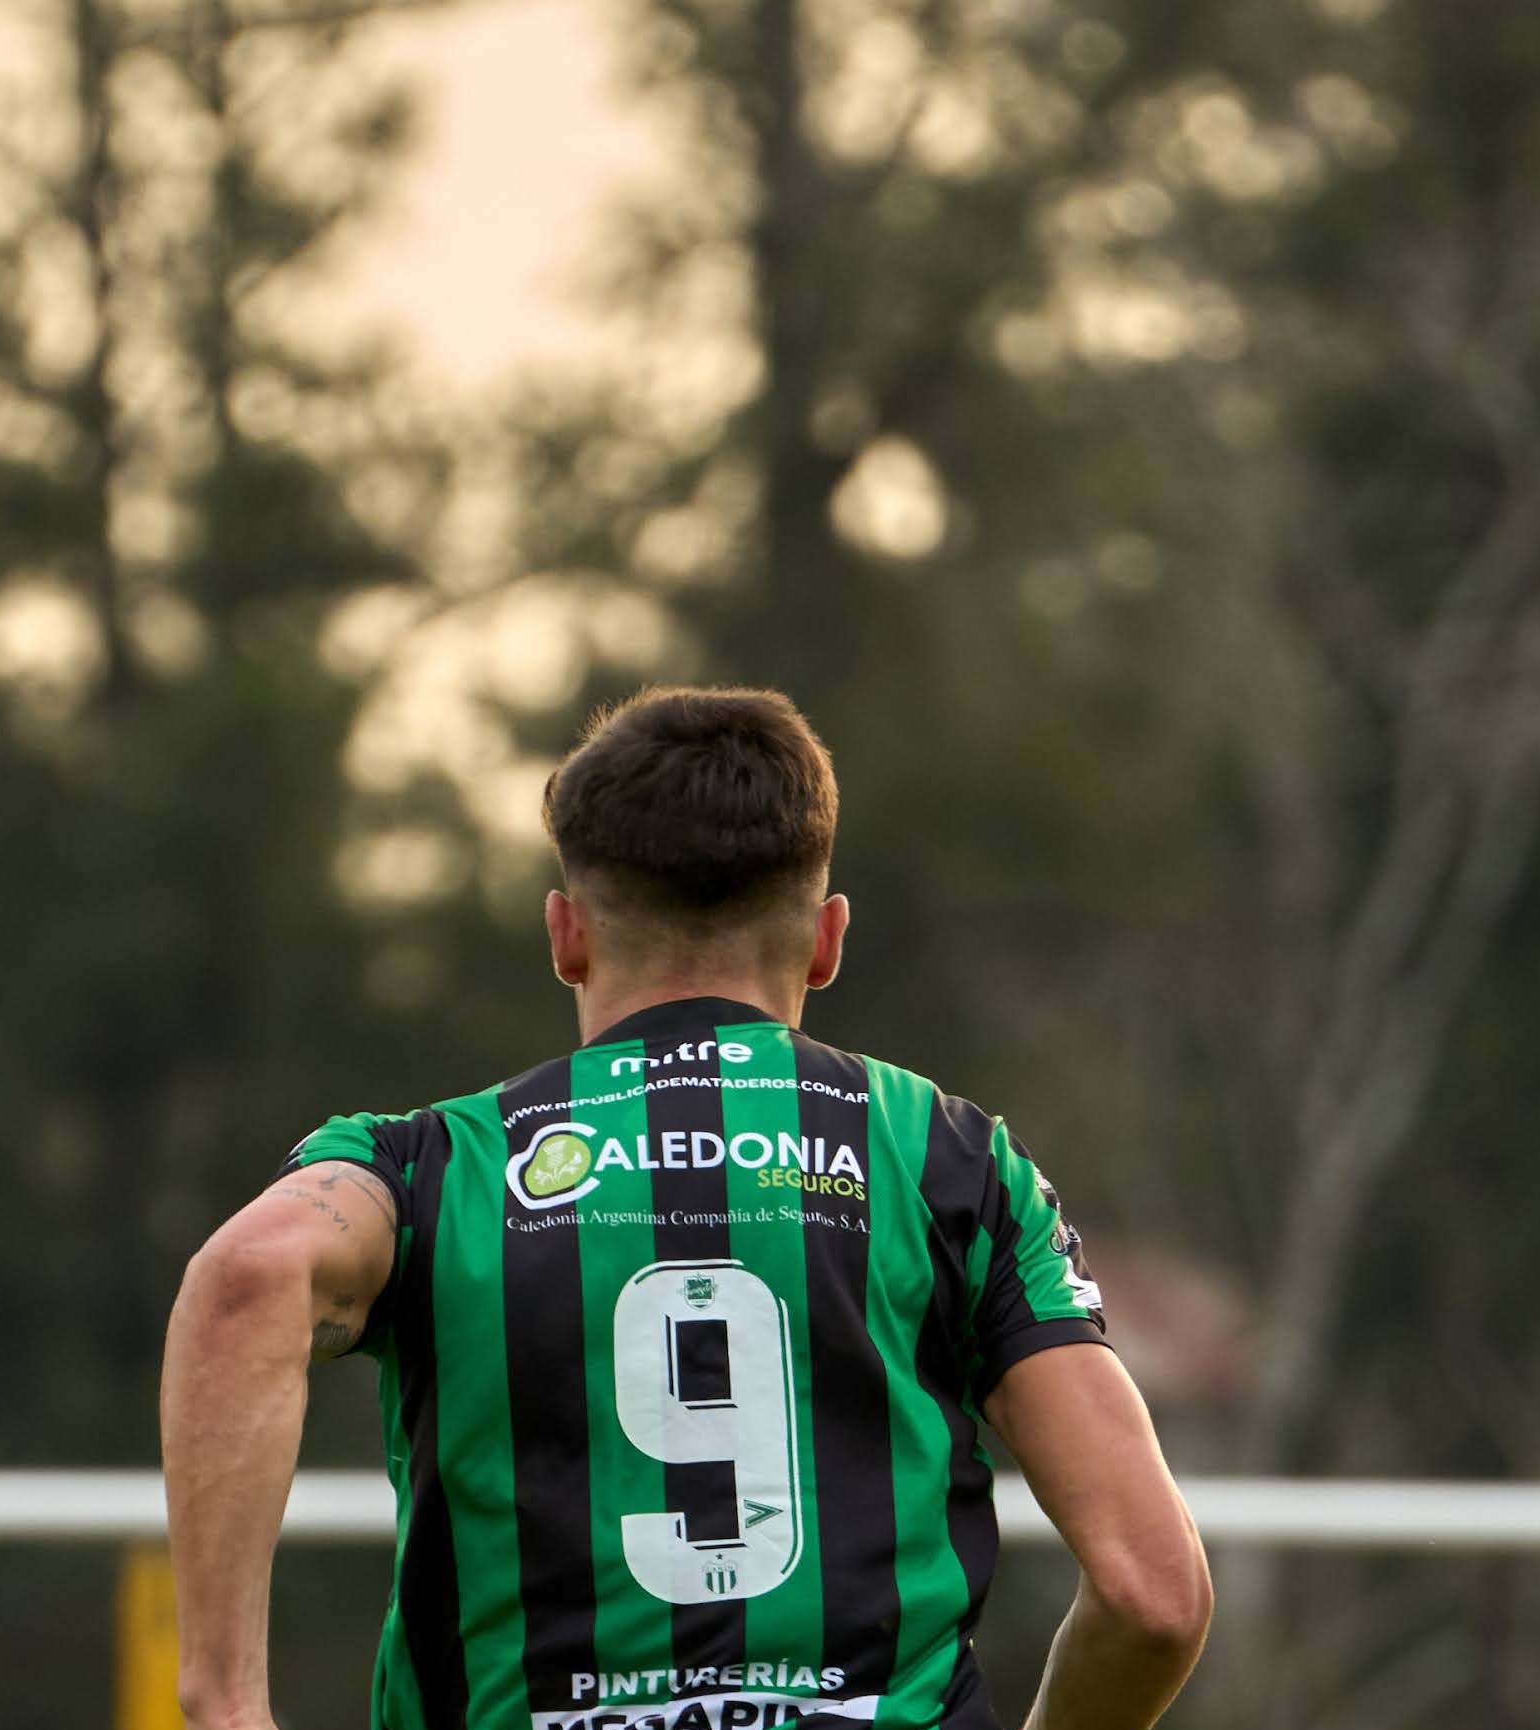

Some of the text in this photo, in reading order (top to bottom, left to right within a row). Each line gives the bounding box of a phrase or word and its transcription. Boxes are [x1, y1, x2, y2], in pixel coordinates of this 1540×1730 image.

[610, 1041, 753, 1077] mitre
[505, 1122, 865, 1210] CALEDONIA
[758, 1168, 866, 1201] SEGUROS
[506, 1213, 585, 1234] Caledonia
[589, 1207, 666, 1229] Argentina
[756, 1204, 774, 1223] de
[778, 1205, 836, 1230] Seguros
[840, 1214, 872, 1235] S.A.
[614, 1258, 804, 1605] 9
